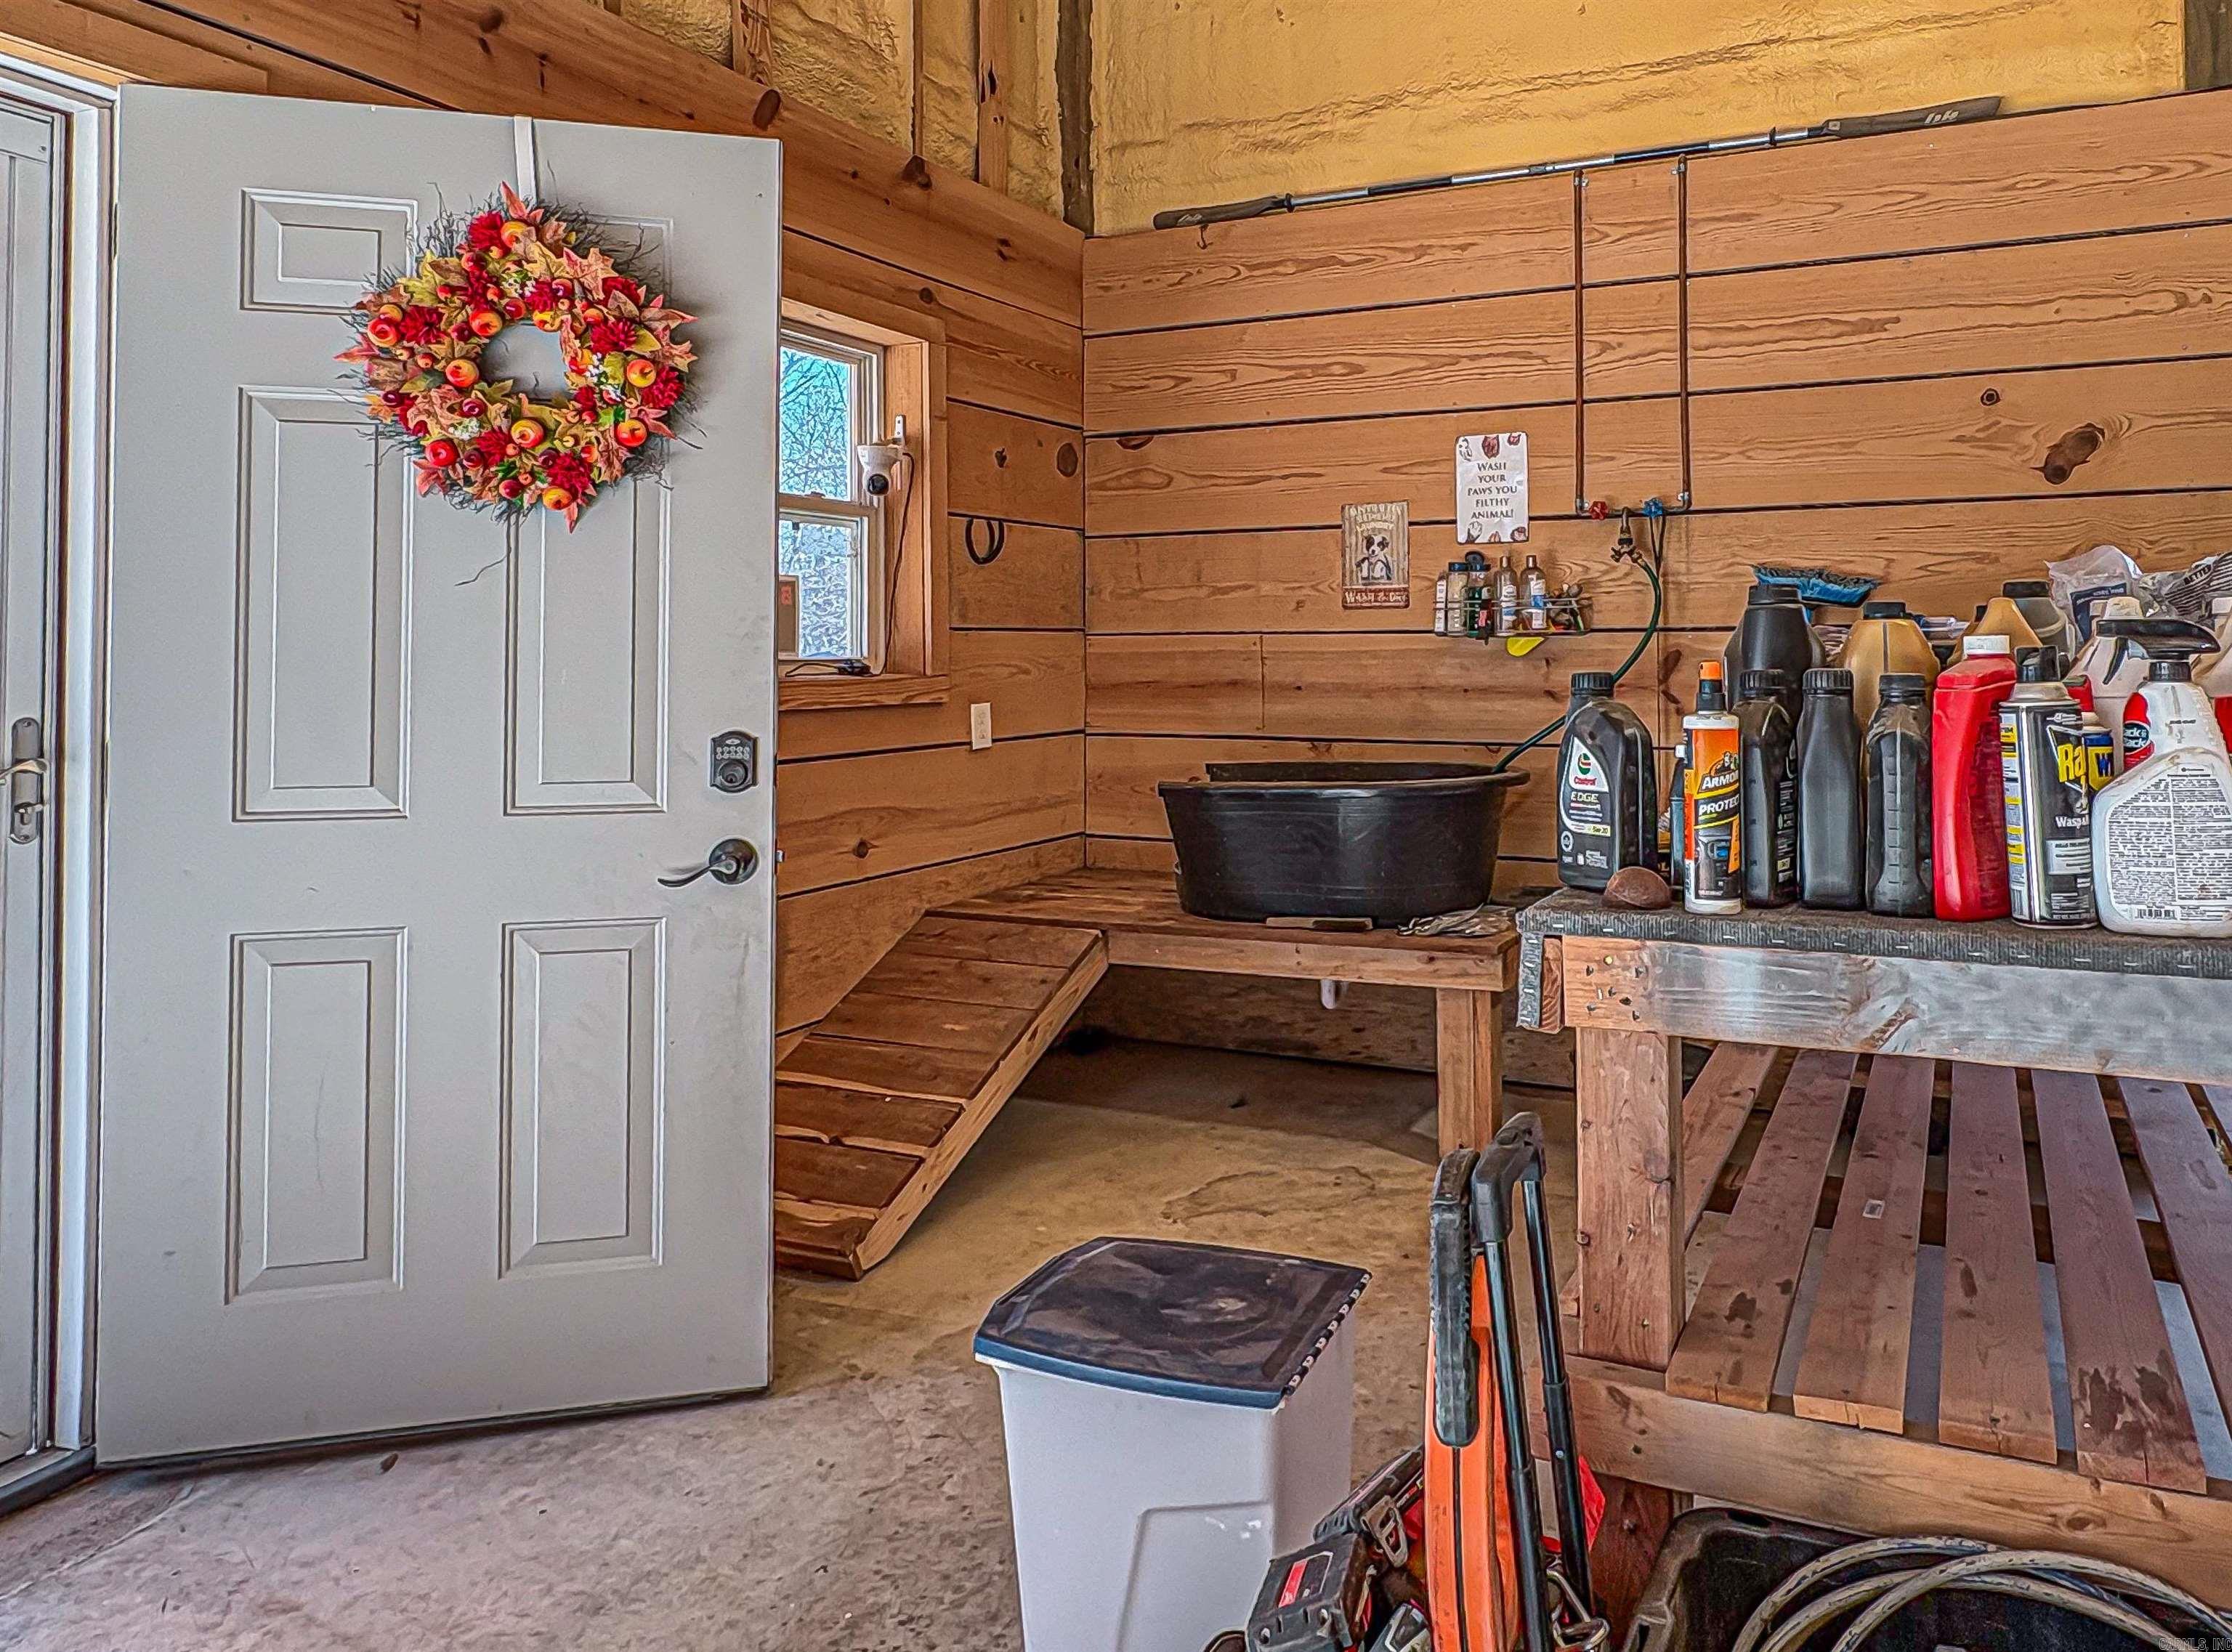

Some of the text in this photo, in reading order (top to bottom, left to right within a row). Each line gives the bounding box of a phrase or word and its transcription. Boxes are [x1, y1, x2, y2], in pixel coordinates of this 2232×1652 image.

[1476, 462, 1506, 471] WASH
[1478, 474, 1506, 483] YOUR
[1468, 485, 1517, 496] PAWS YOU
[1476, 498, 1510, 508] FILTHY
[2057, 743, 2086, 782] Ra
[1571, 791, 1599, 803] EDGE
[1698, 793, 1739, 817] PROTEC
[2055, 816, 2082, 830] Wasp
